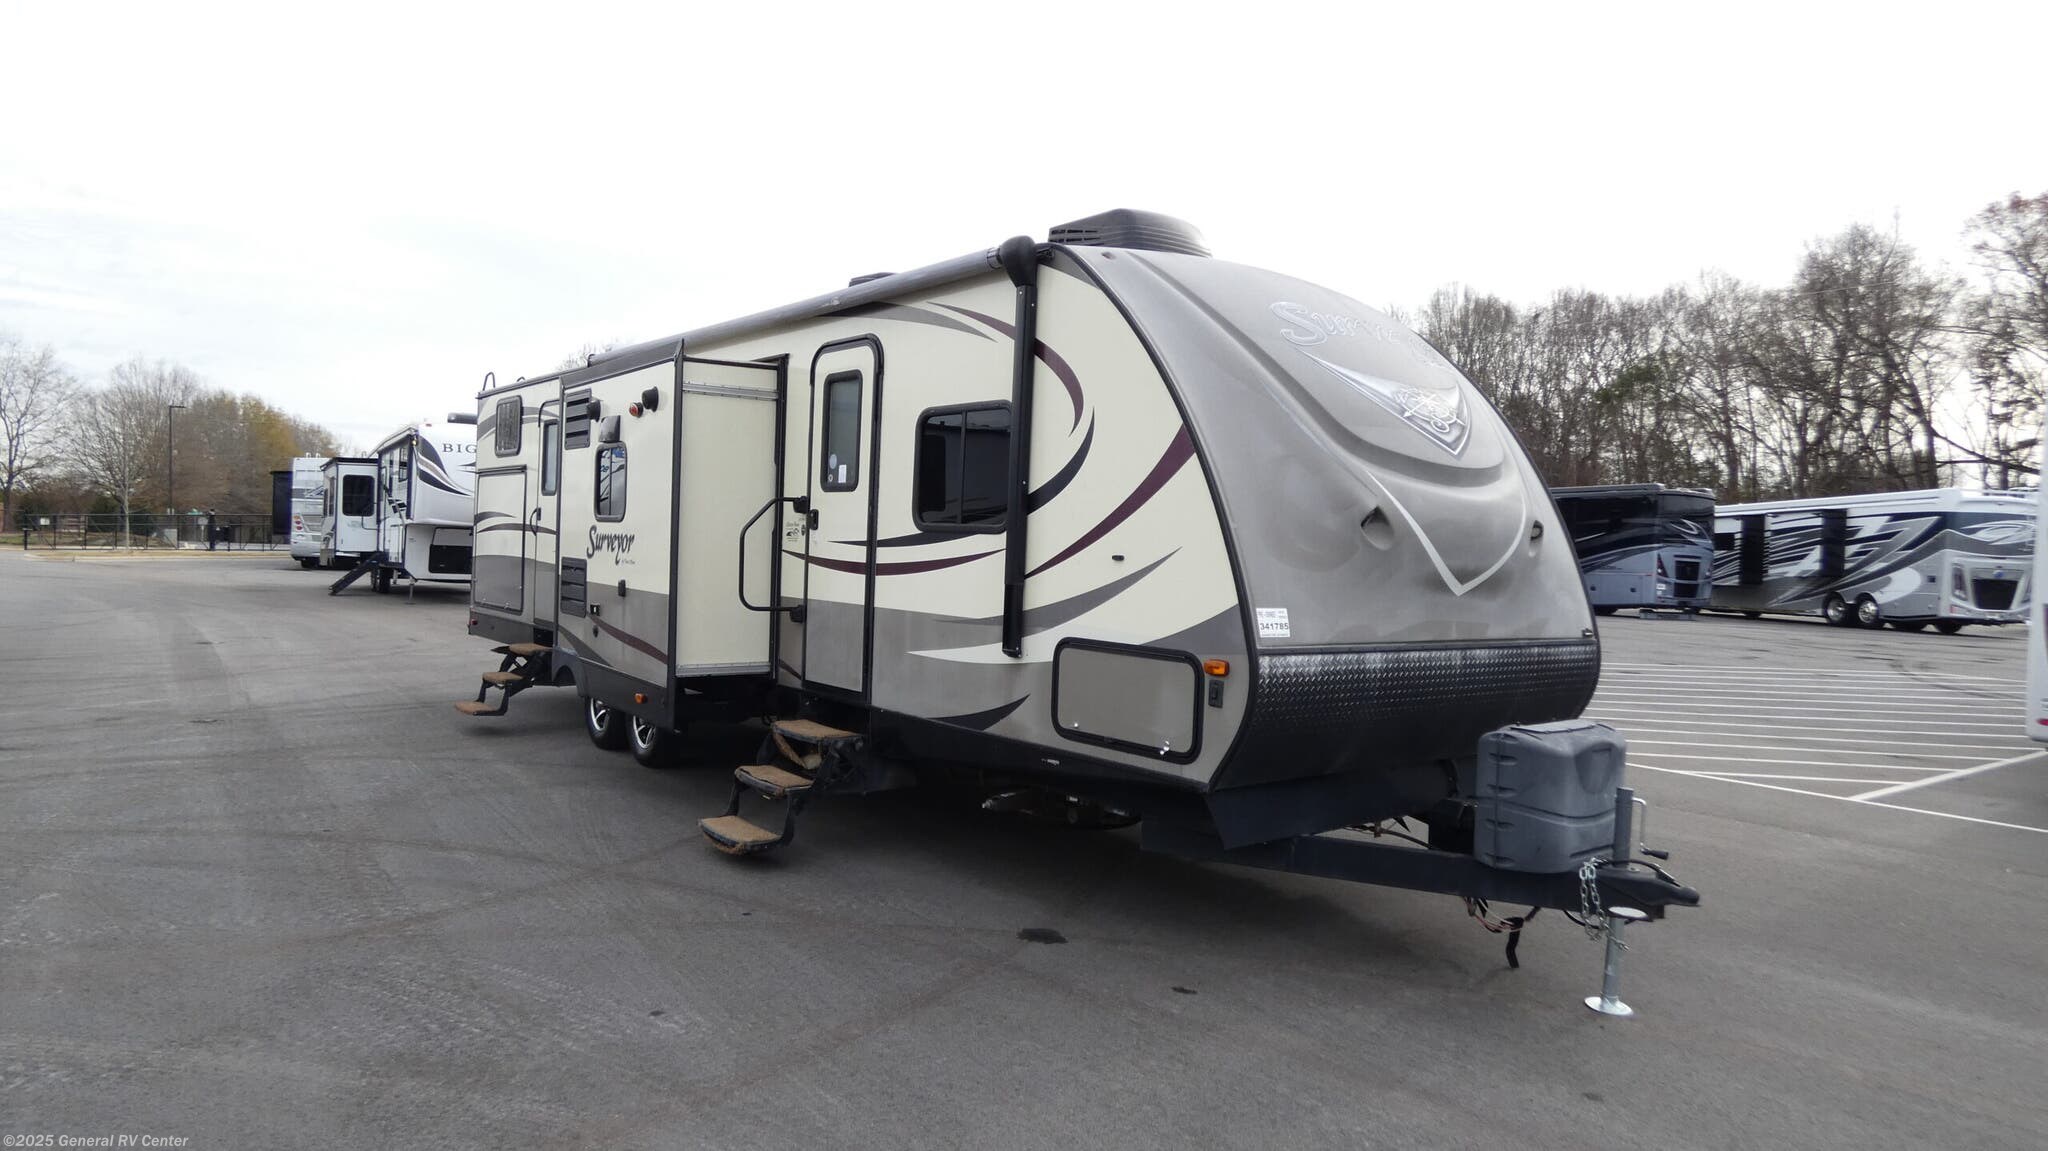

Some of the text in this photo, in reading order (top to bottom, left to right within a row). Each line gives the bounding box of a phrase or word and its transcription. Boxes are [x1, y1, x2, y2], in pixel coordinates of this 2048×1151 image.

[442, 443, 477, 454] BIG
[586, 524, 635, 566] Surveyor
[1259, 622, 1289, 631] 341785
